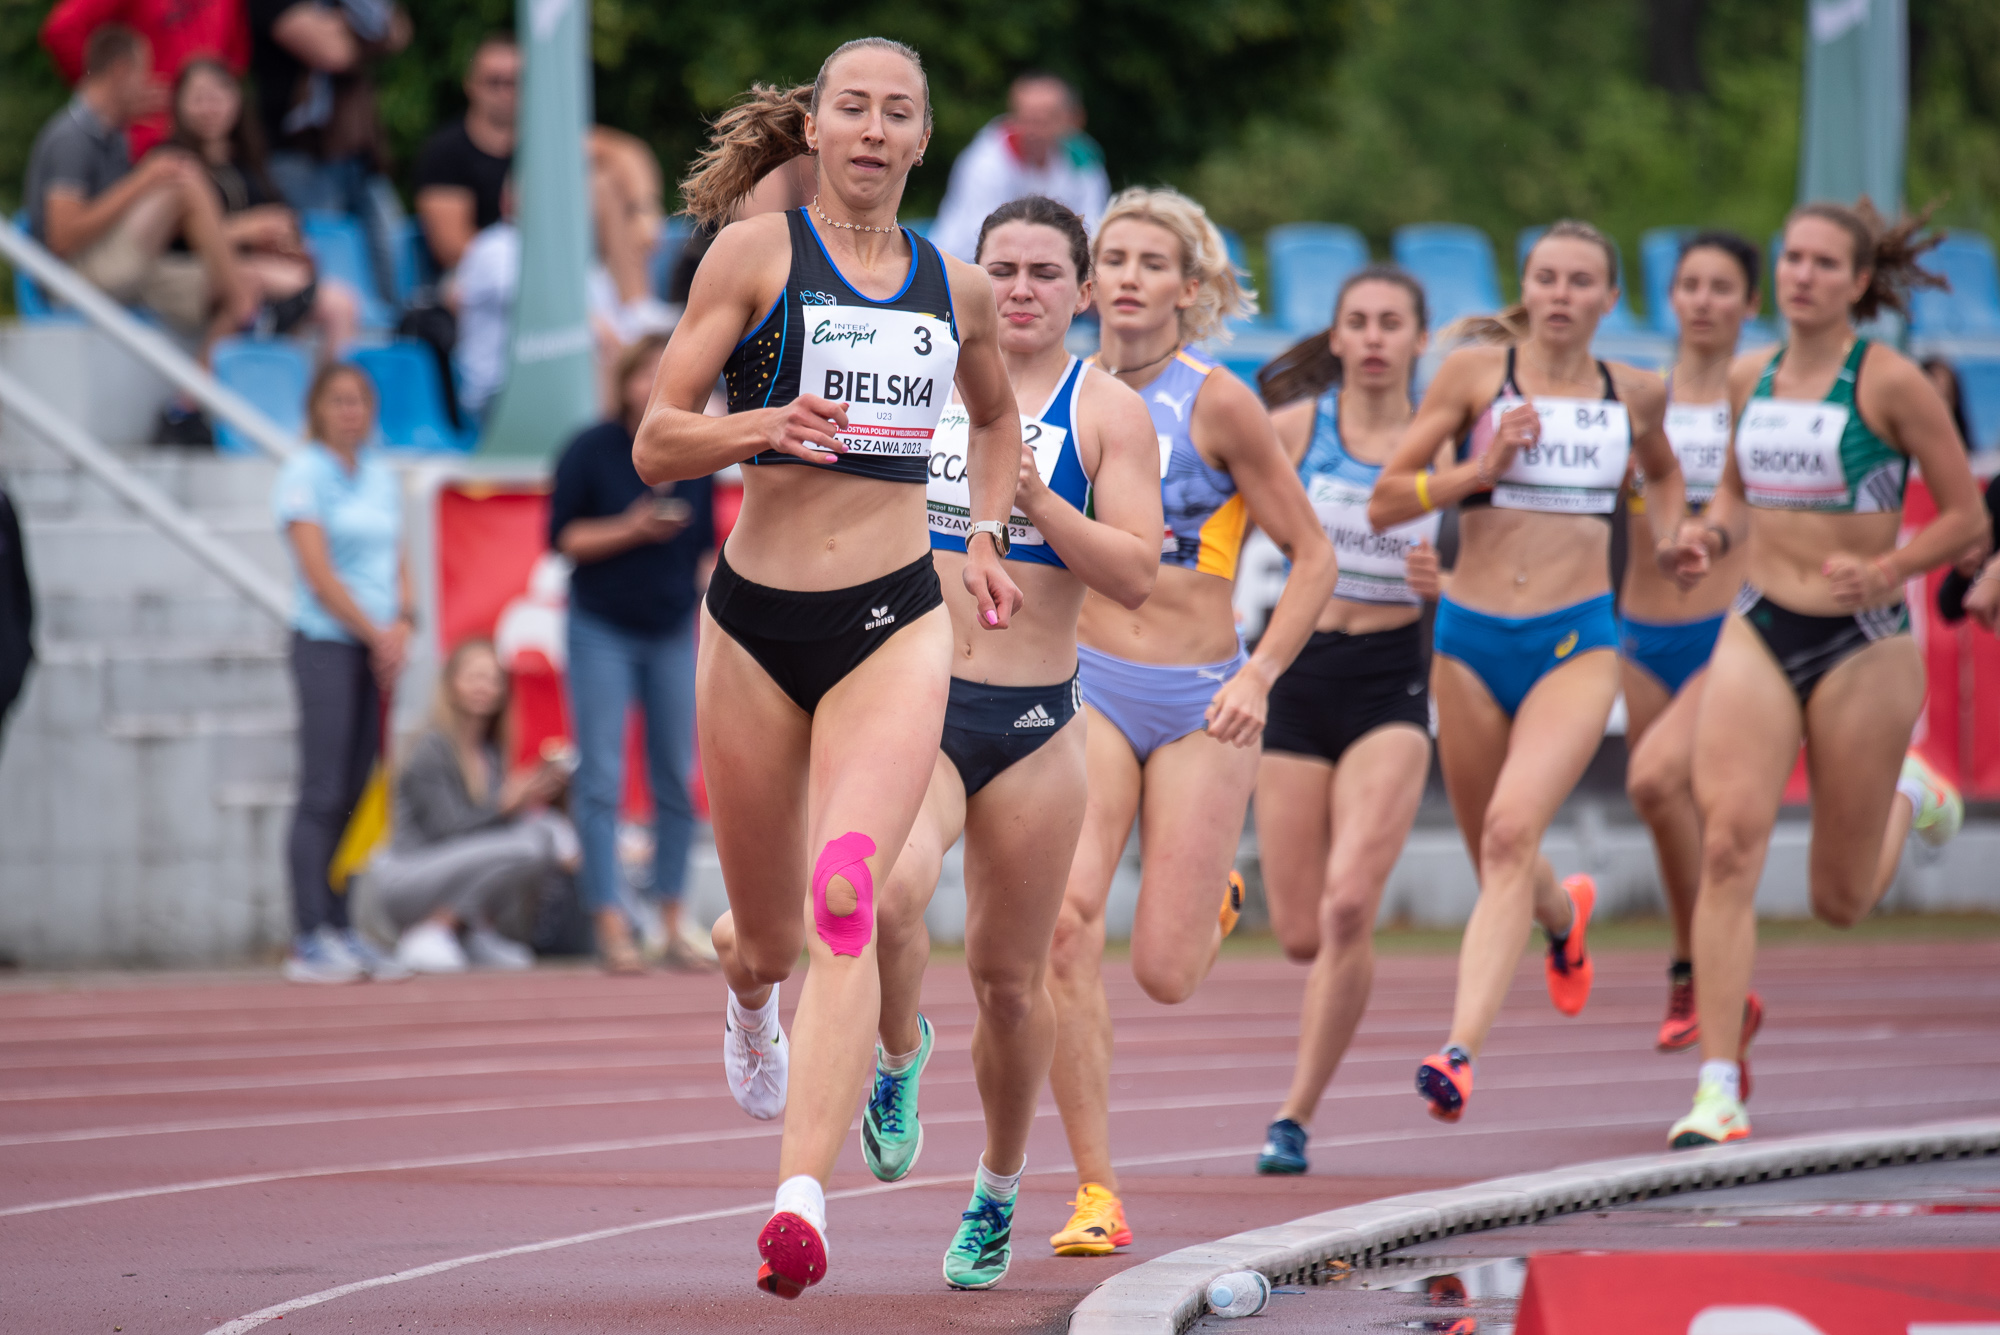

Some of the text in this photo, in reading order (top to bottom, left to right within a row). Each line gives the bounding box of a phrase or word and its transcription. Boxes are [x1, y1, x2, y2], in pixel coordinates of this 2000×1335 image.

[811, 319, 877, 349] Europol
[913, 325, 933, 356] 3
[823, 369, 934, 408] BIELSKA
[876, 411, 893, 421] U23
[1575, 407, 1609, 431] 84
[870, 427, 890, 436] POLSKI
[901, 442, 922, 455] 2023
[1523, 443, 1602, 470] BYLIK
[1009, 527, 1026, 538] 23
[864, 614, 895, 631] erima
[1013, 716, 1056, 729] adidas
